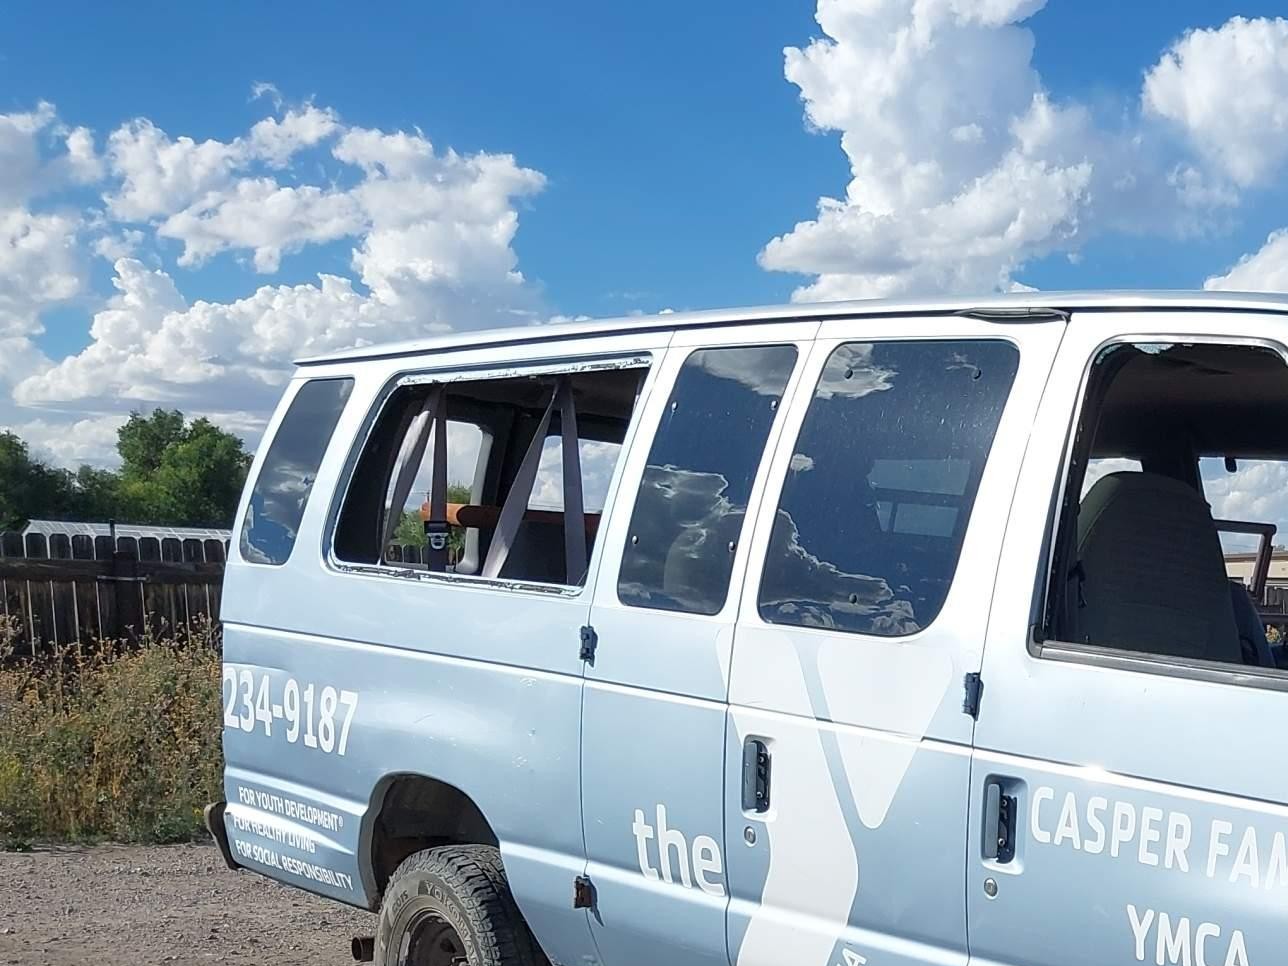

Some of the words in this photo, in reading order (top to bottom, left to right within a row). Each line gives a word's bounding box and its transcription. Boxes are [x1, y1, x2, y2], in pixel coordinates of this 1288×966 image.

[223, 667, 359, 756] 234-9187
[238, 785, 256, 806] FOR
[256, 791, 284, 814] YOUTH
[1030, 786, 1193, 873] CASPER
[233, 815, 252, 832] FOR
[252, 820, 287, 844] HEALTHY
[287, 830, 316, 854] LIVING
[235, 840, 252, 859] FOR
[252, 845, 283, 870] SOCIAL
[281, 855, 354, 891] RESPONSIBILITY
[633, 803, 727, 897] the
